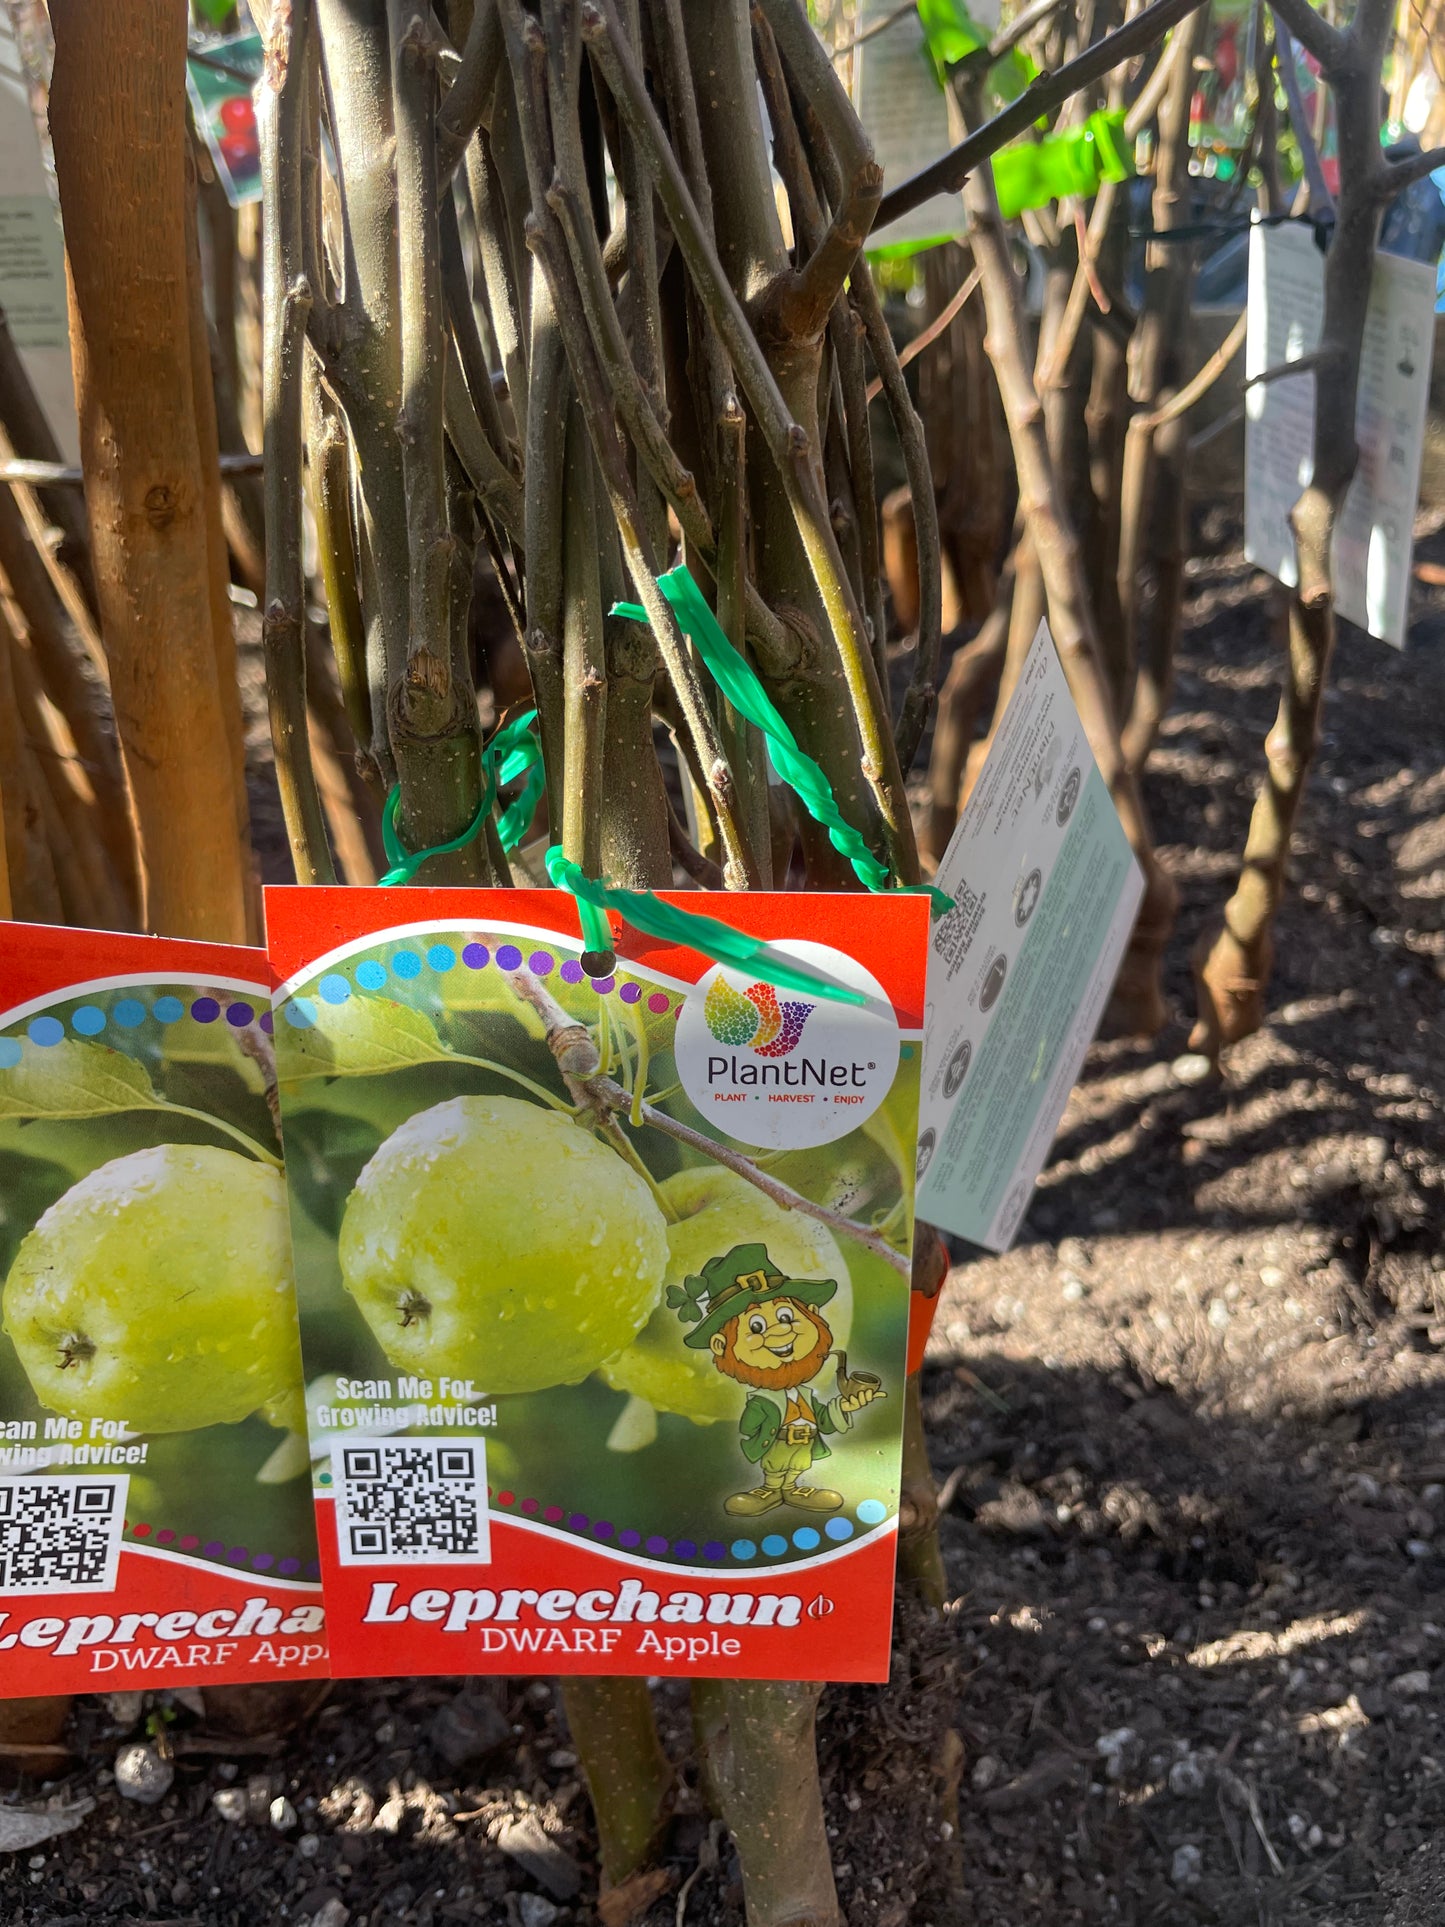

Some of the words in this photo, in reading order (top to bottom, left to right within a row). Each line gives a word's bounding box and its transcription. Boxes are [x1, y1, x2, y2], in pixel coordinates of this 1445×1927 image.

[993, 691, 1054, 834] www.plantnet.com.au
[714, 1093, 747, 1102] PLANT
[768, 1094, 815, 1103] HARVEST
[833, 1095, 865, 1105] ENJOY
[335, 1377, 391, 1399] Scan
[397, 1376, 433, 1399] Me
[439, 1377, 475, 1399] For
[316, 1403, 409, 1427] Growing
[416, 1403, 497, 1426] Advice!
[0, 1420, 37, 1440] can
[44, 1417, 83, 1440] Me
[89, 1417, 129, 1440] For
[57, 1443, 149, 1465] Advice!
[362, 1577, 803, 1633] Leprechaun
[480, 1627, 622, 1653] DWARF
[636, 1629, 741, 1662] Apple
[90, 1642, 238, 1673] DWARF
[249, 1641, 330, 1668] App
